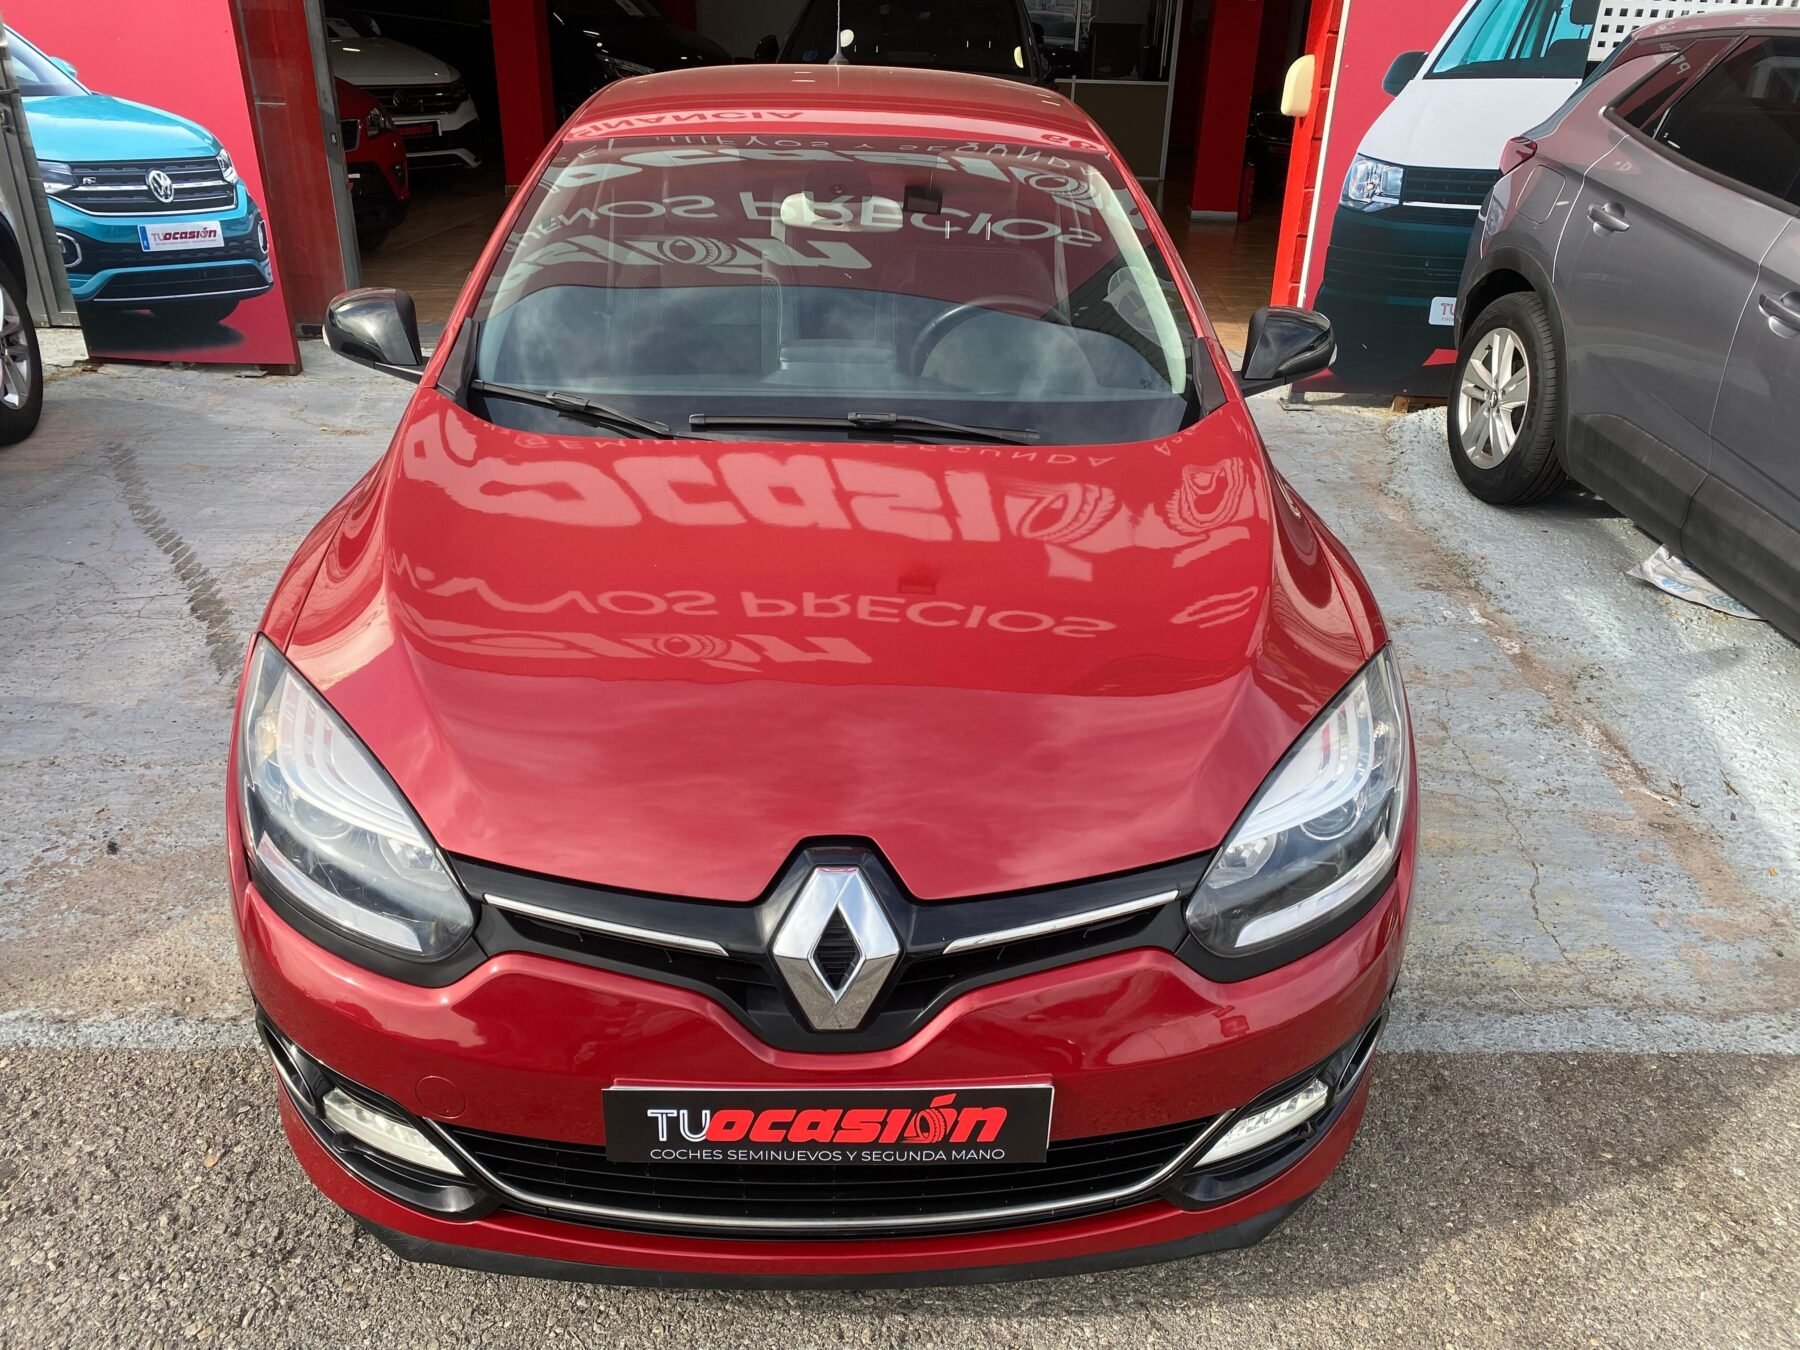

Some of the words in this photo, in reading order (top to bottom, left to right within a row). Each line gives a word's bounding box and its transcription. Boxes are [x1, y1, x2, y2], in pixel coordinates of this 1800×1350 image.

[650, 1149, 723, 1160] COCHES
[727, 1149, 842, 1162] SEMINUEVOS
[846, 1150, 857, 1161] Y
[861, 1149, 947, 1162] SEGUNDA
[951, 1148, 1006, 1161] MANO
